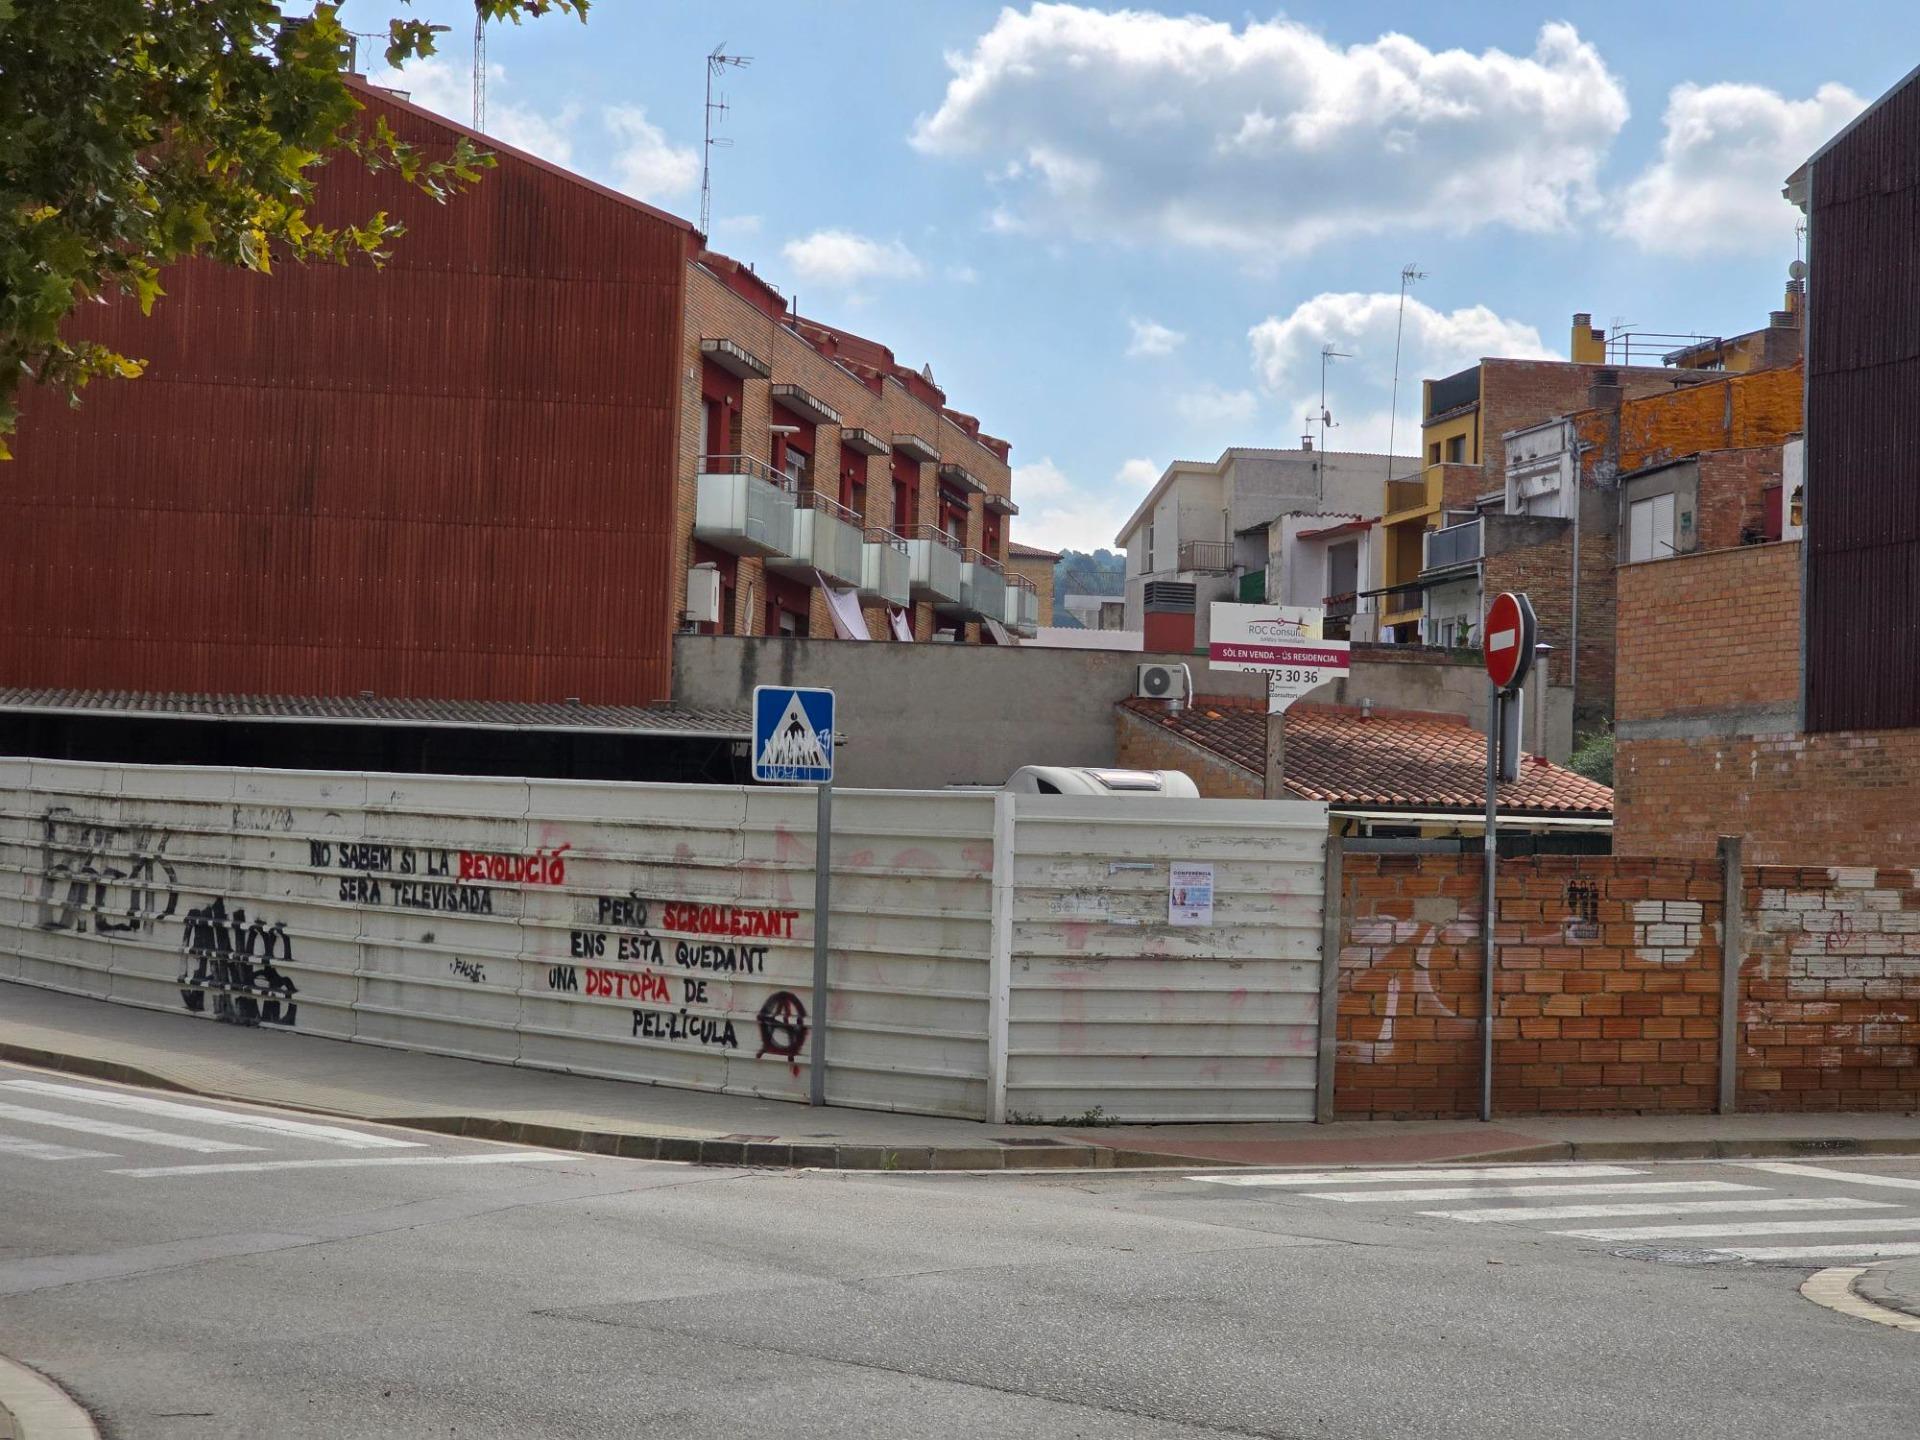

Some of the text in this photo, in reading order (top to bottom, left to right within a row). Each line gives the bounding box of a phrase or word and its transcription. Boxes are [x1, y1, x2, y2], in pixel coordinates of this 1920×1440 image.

[1249, 625, 1268, 635] ROC
[1223, 648, 1236, 657] SÒL
[1238, 650, 1248, 658] EN
[1249, 651, 1274, 660] VENDA
[1293, 653, 1338, 663] RESIDENCIAL
[1285, 670, 1300, 682] 30
[1304, 671, 1318, 683] 36
[309, 839, 571, 885] NO SABEM SI LA REVOLUCIÓ
[340, 872, 493, 913] SERÀ TELEVISADA
[599, 891, 799, 938] PERÒ SCROLLEJANT
[570, 930, 769, 974] ENS ESTÀ QUEDANT
[550, 967, 578, 992] UNA
[684, 978, 708, 1003] DE
